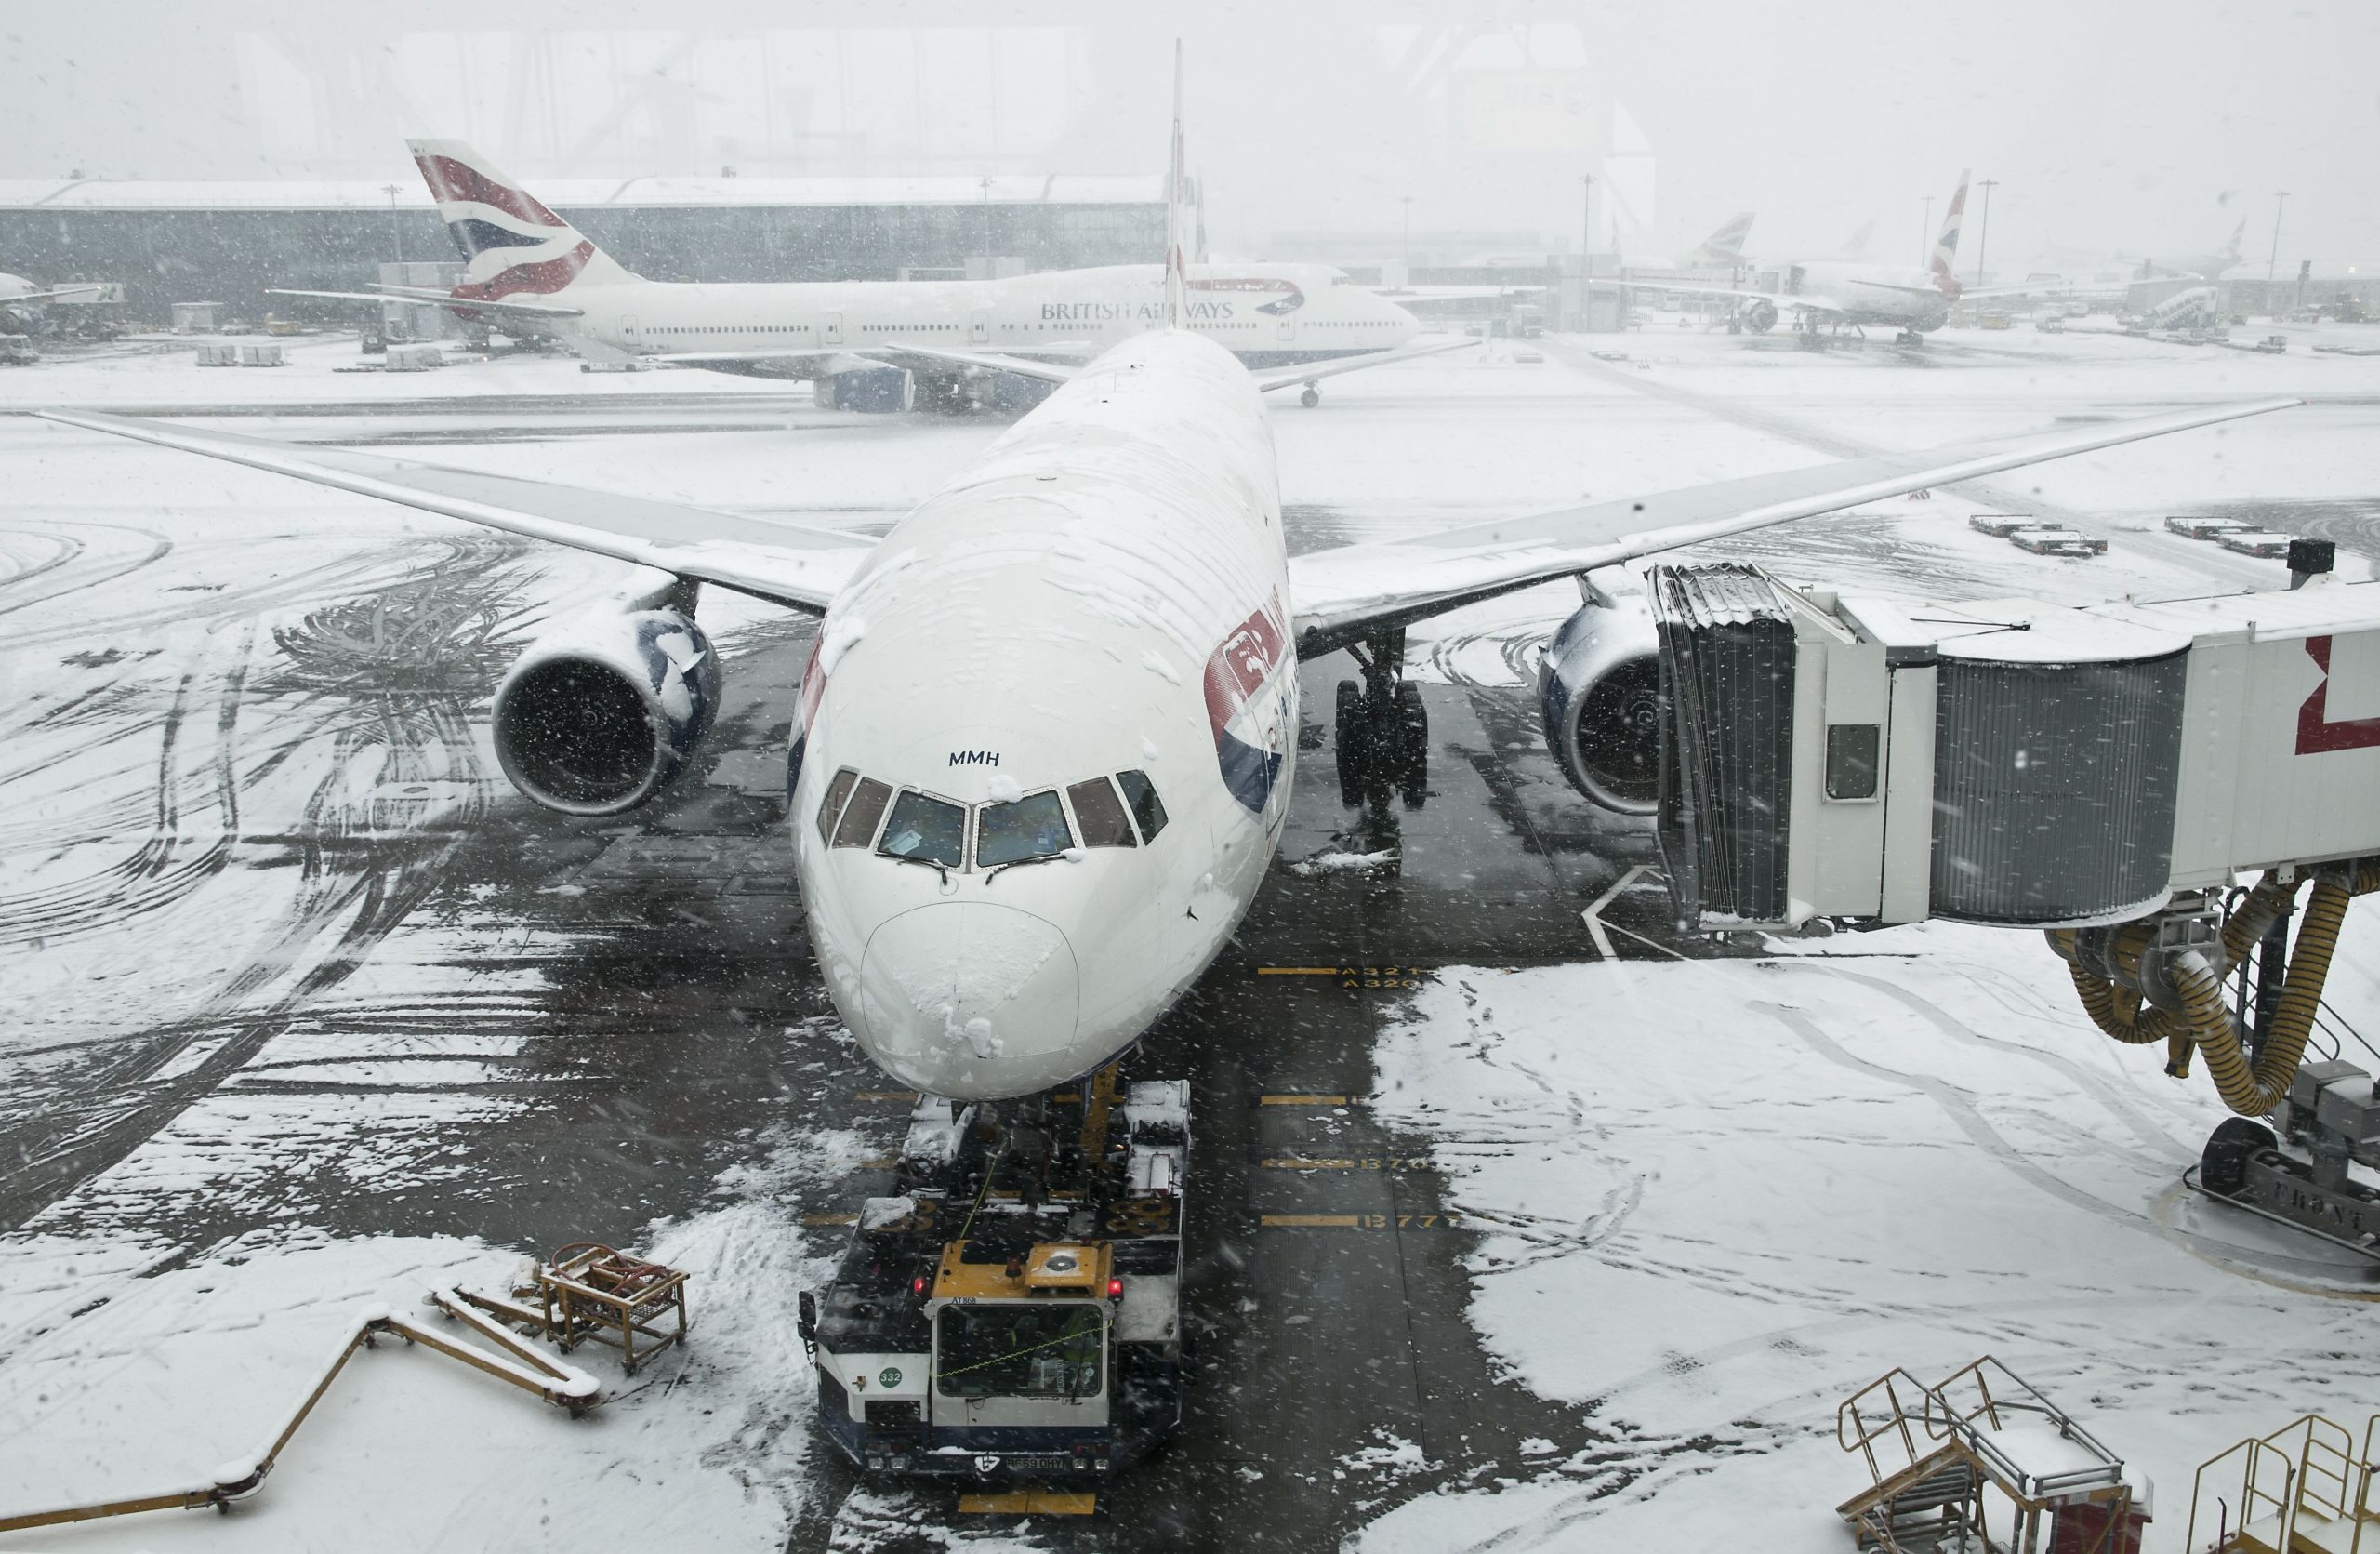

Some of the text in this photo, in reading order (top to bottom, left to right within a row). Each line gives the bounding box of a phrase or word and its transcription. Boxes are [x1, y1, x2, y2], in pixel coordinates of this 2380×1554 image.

[1041, 302, 1234, 320] BRITISH AIWAYS
[948, 750, 1000, 767] MMH
[1342, 967, 1418, 976] A321
[1342, 979, 1421, 988] A320
[880, 1373, 901, 1382] 332
